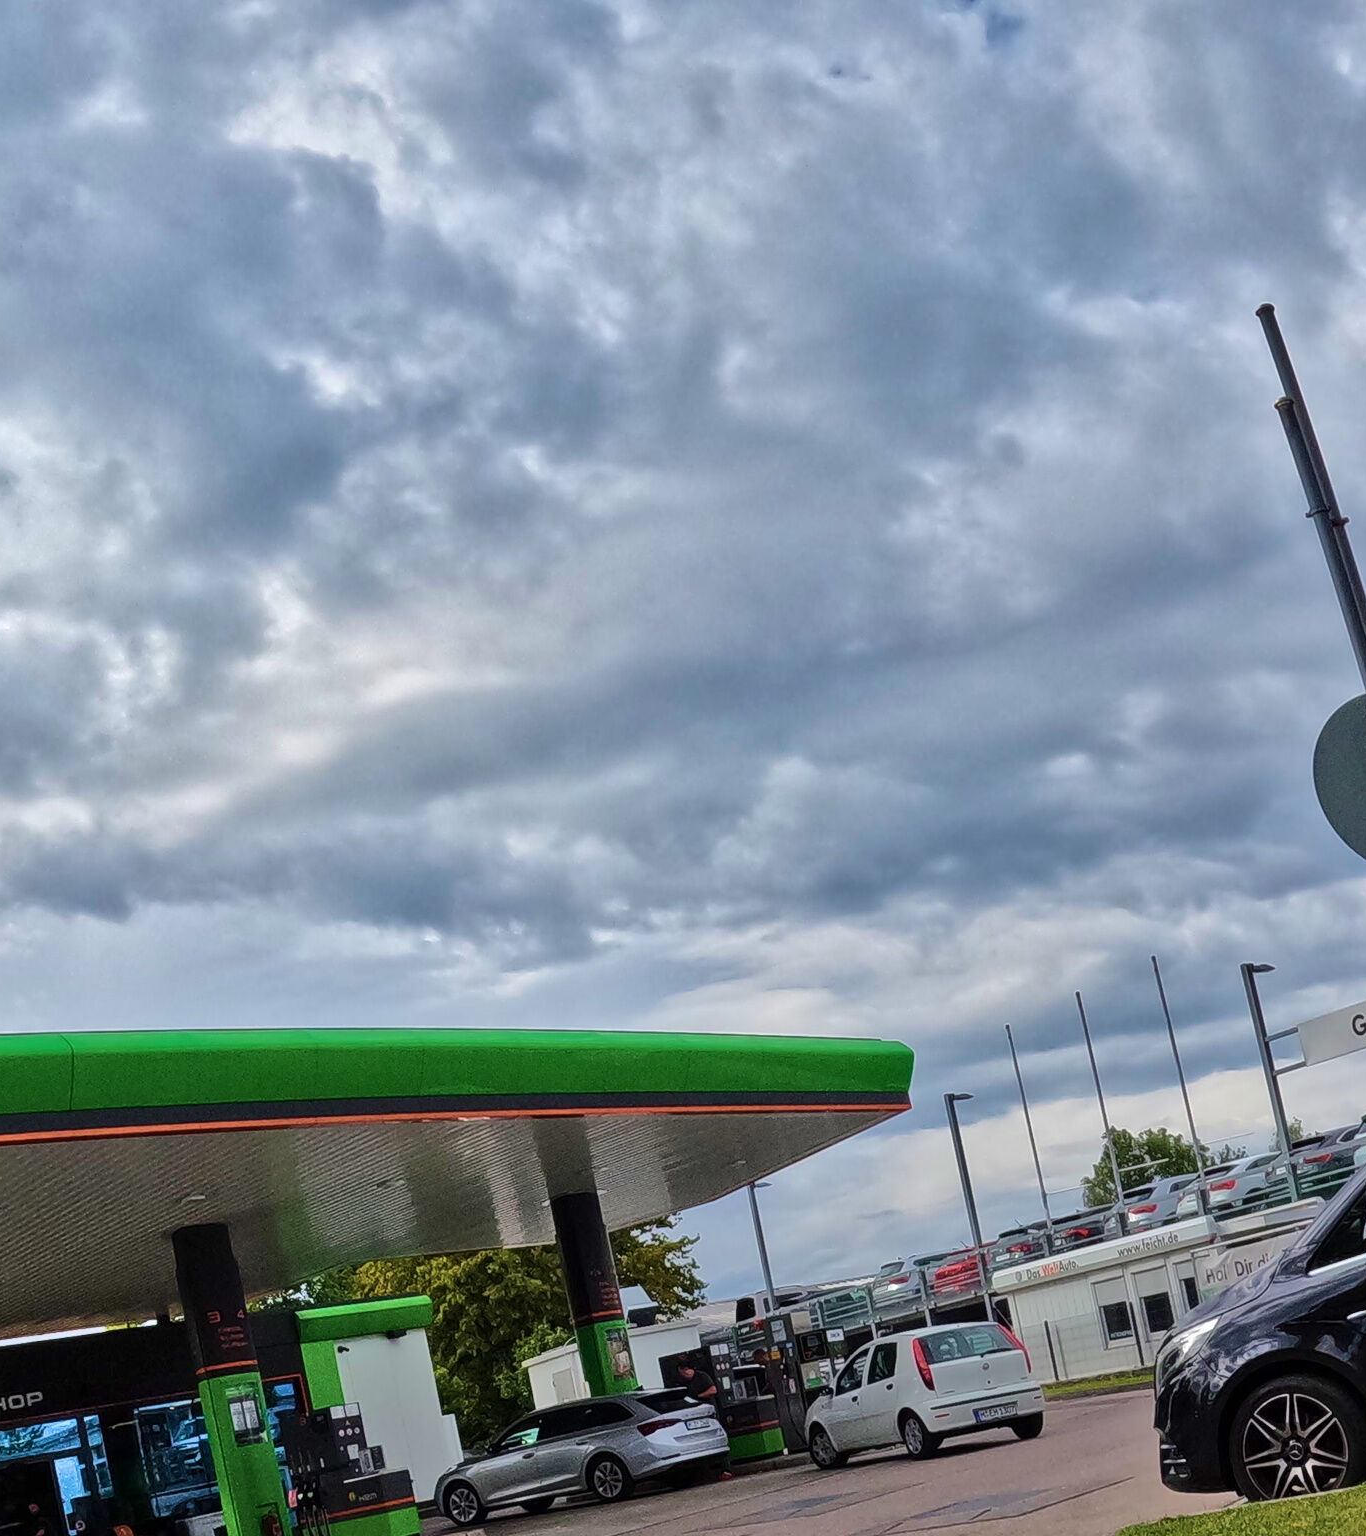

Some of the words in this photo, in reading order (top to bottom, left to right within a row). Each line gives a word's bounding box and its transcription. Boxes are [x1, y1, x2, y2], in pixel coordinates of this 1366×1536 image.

[1117, 1233, 1179, 1257] www.feicht.de
[1026, 1268, 1041, 1280] Das
[1206, 1264, 1228, 1284] Hol
[1234, 1258, 1253, 1277] Dir
